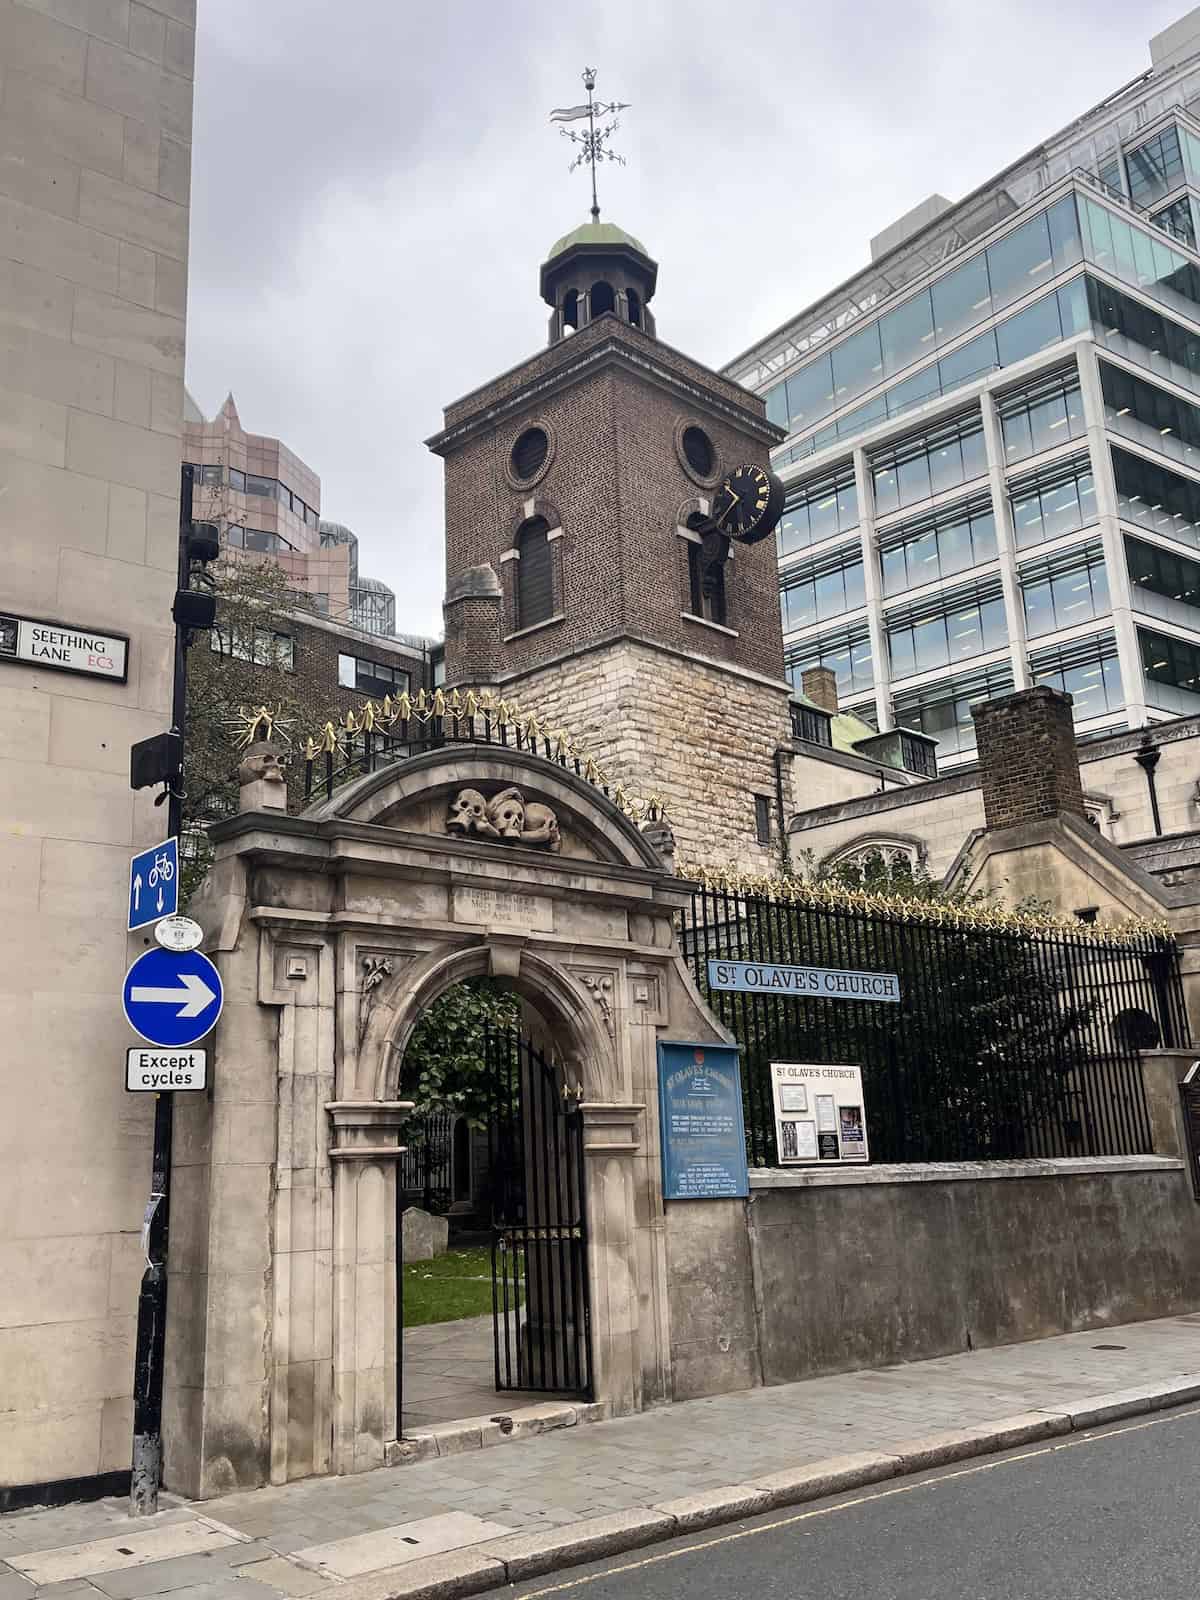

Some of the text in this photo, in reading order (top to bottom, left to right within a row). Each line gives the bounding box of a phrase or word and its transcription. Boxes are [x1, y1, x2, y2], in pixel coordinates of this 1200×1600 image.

[32, 628, 105, 653] SEETHING
[31, 643, 113, 670] LANE EC3
[744, 967, 819, 991] OLAVE'S
[824, 973, 895, 996] CHURCH
[139, 1053, 195, 1070] Except
[141, 1070, 193, 1087] cycles
[822, 1069, 856, 1079] CHURCH
